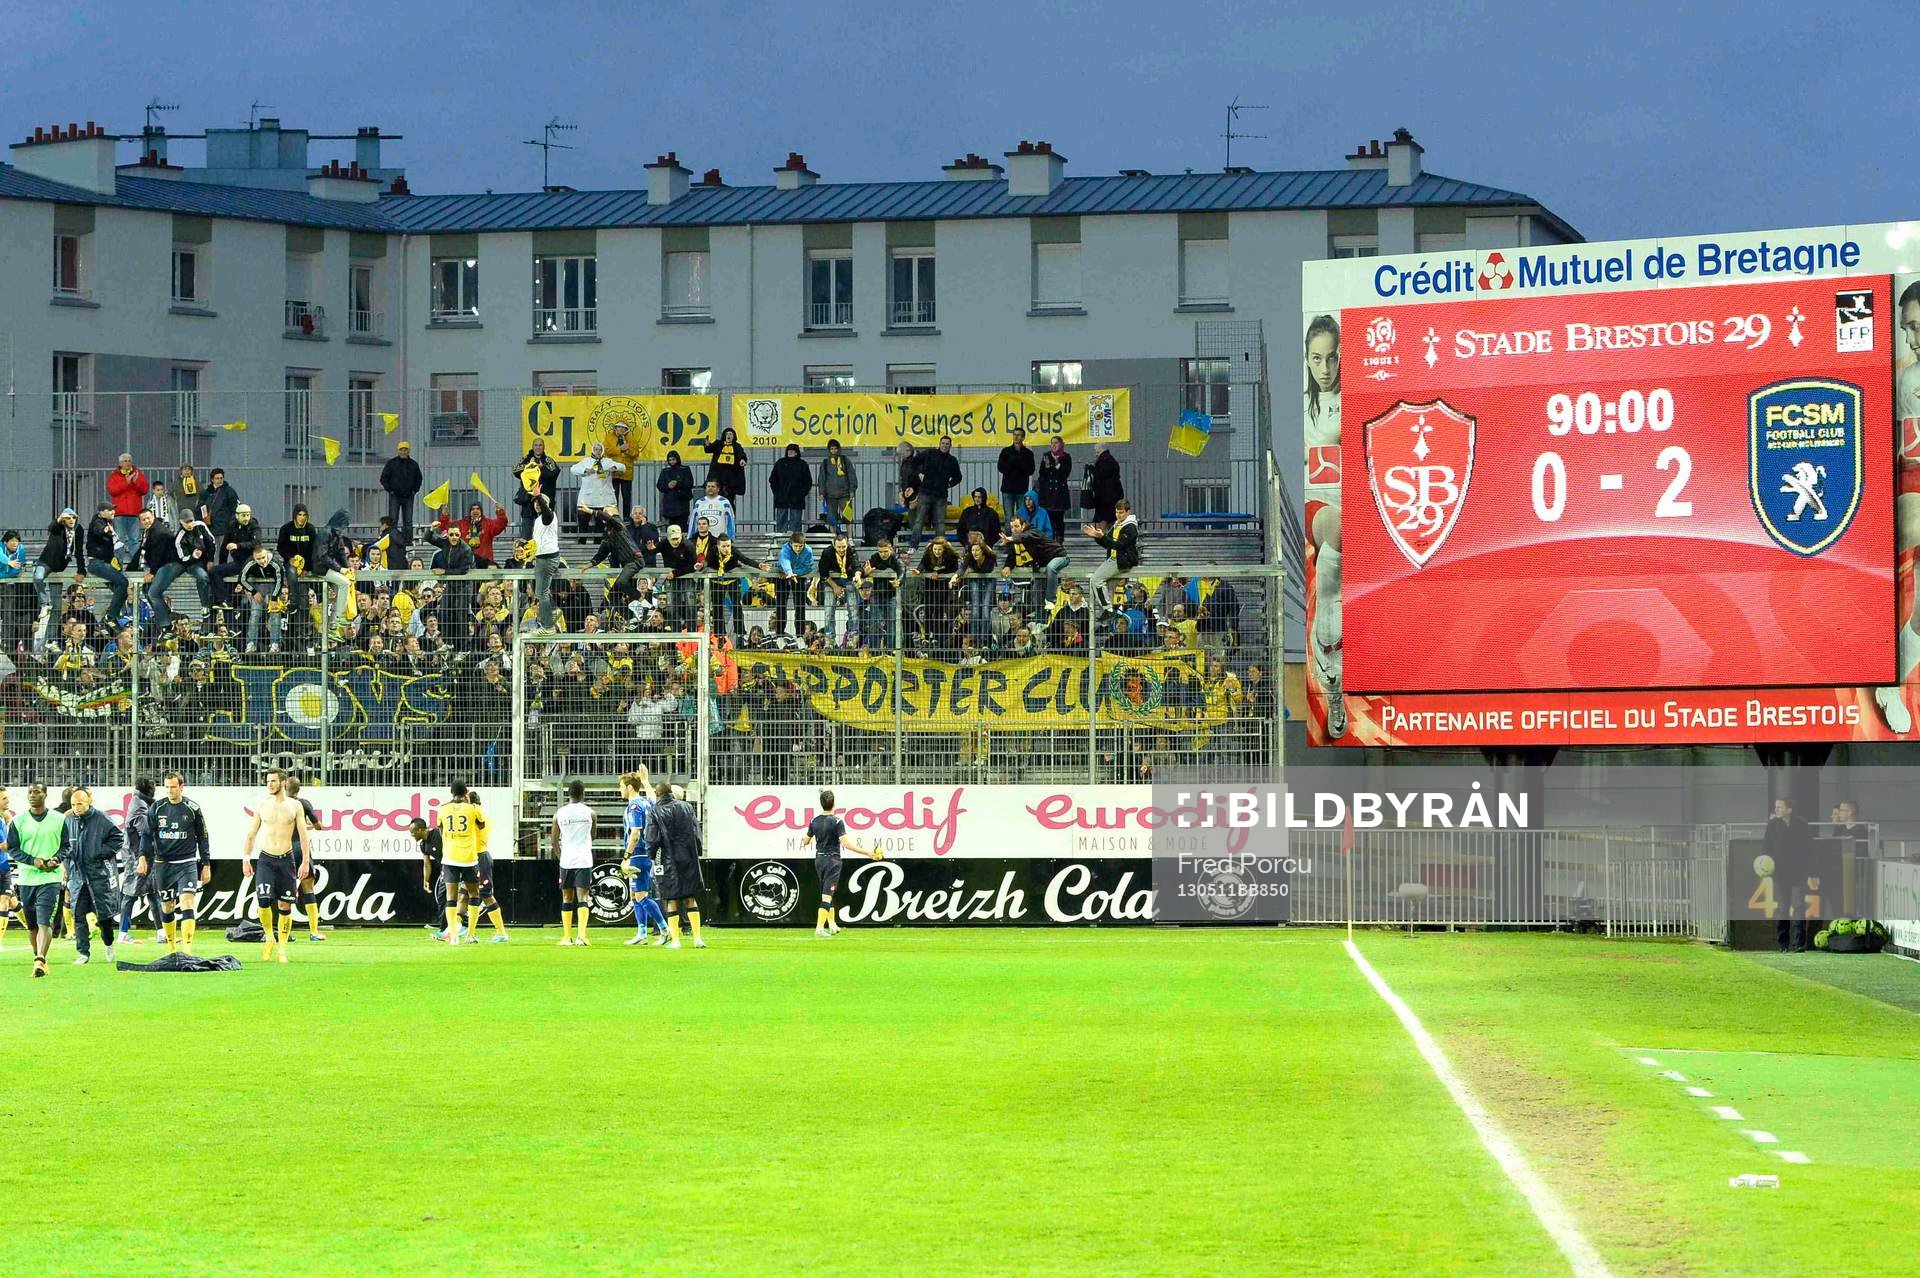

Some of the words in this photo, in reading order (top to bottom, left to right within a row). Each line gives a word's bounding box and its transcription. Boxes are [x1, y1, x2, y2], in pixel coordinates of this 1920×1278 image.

[1374, 261, 1474, 298] Crédit
[1519, 249, 1633, 288] Mutuel
[1644, 247, 1686, 279] de
[1699, 241, 1861, 276] Bretagne
[1455, 329, 1554, 359] STADE
[1565, 321, 1715, 353] BRESTOIS
[1723, 313, 1772, 350] 29
[1839, 327, 1870, 340] LFP
[588, 400, 612, 433] CRAZY
[626, 400, 650, 429] LIONS
[792, 405, 877, 435] Section
[885, 403, 974, 436] "Jeunes
[982, 405, 996, 434] &
[1005, 401, 1072, 434] bleus"
[1104, 409, 1112, 436] FCSM
[1547, 388, 1674, 436] 90:00
[1766, 402, 1846, 428] FCSM
[657, 412, 710, 446] 92
[752, 436, 777, 446] 2010
[1766, 429, 1815, 440] FOOTBALL
[1818, 428, 1846, 438] CLUB
[1383, 465, 1458, 508] SB
[1531, 451, 1567, 522] 0
[1655, 446, 1693, 518] 2
[1396, 504, 1445, 537] 29
[1382, 706, 1513, 731] PARTENAIRE
[1521, 709, 1617, 730] OFFICIEL
[1624, 709, 1656, 729] DU
[1664, 701, 1738, 727] STADE
[1746, 699, 1861, 726] BRESTOIS
[446, 815, 467, 832] 13
[1026, 787, 1261, 854] eurodif
[309, 839, 353, 852] AISON
[363, 839, 371, 852] &
[856, 837, 863, 849] &
[874, 837, 916, 851] MODE
[1079, 837, 1138, 850] MAISON
[1148, 837, 1156, 850] &
[1166, 836, 1208, 850] MODE
[767, 866, 786, 876] Cola
[162, 889, 175, 901] 27
[258, 883, 271, 895] 17
[839, 861, 1028, 923] Breizh
[1044, 864, 1160, 922] Cola
[1748, 876, 1778, 918] 4
[752, 906, 780, 917] phare
